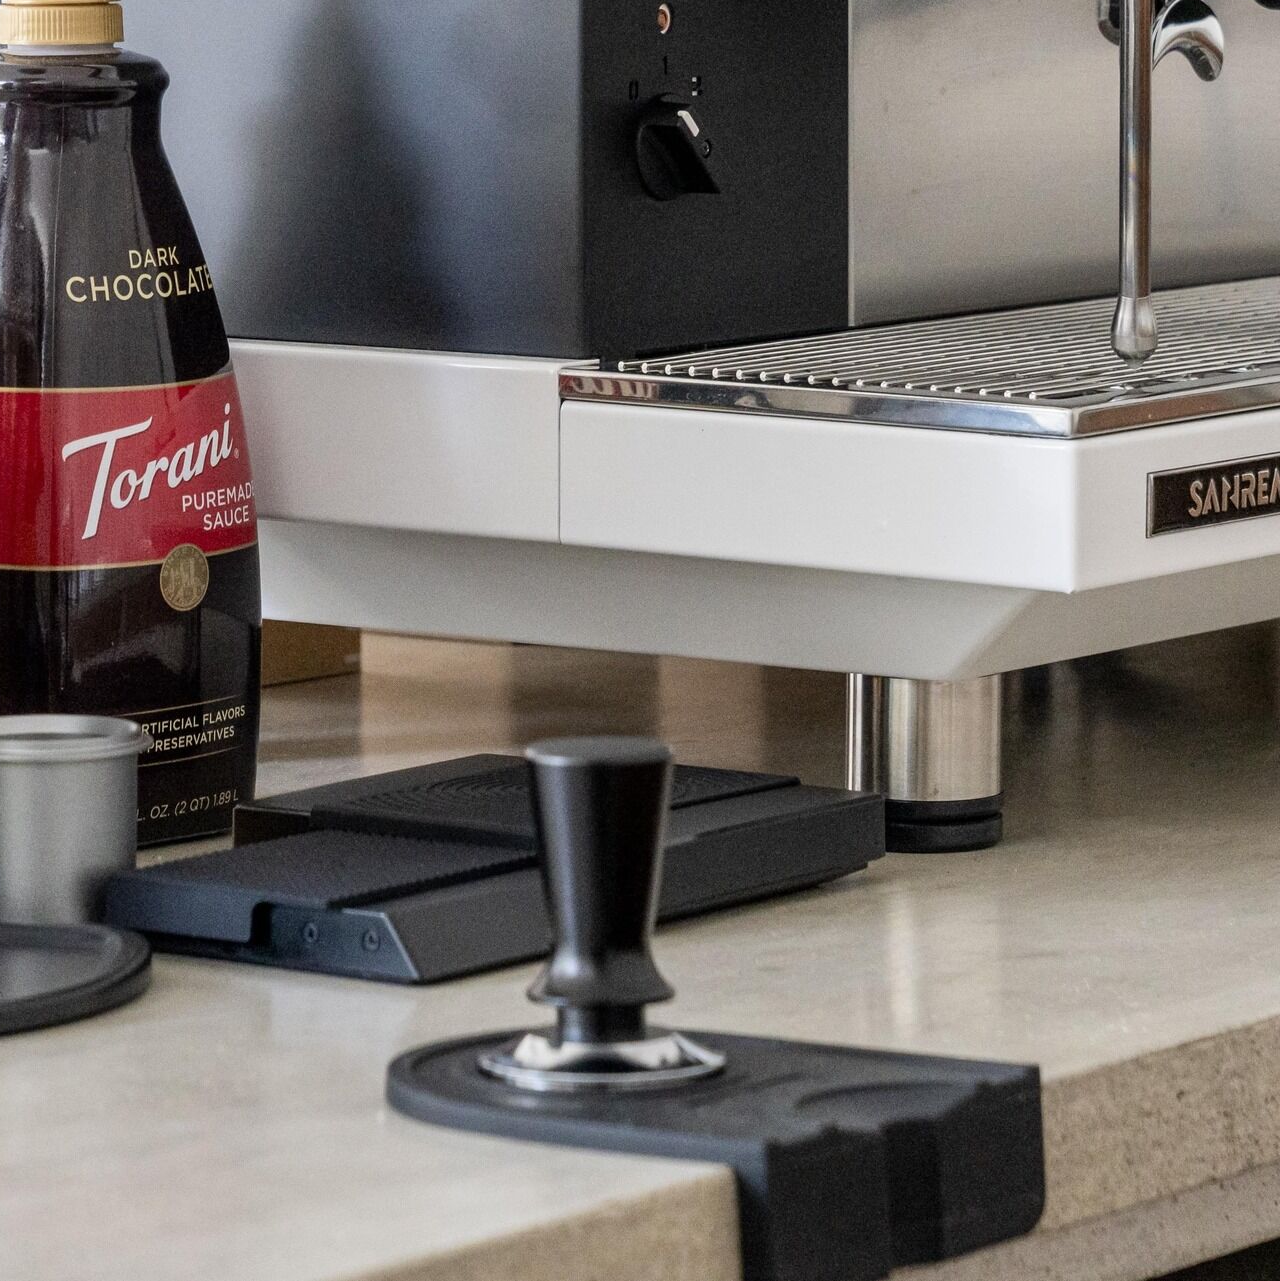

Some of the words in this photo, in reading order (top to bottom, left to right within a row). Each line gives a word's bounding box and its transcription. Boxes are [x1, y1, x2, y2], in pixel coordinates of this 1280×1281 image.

[128, 245, 180, 269] DARK
[65, 263, 214, 303] CHOCOLATE
[61, 402, 234, 540] Torani
[202, 504, 250, 531] SAUCE
[141, 714, 200, 736] RTIFICIAL
[202, 704, 246, 726] FLAVORS
[136, 807, 146, 822] L.
[150, 803, 170, 820] OZ.
[174, 799, 186, 817] (2
[189, 794, 210, 813] QT)
[213, 789, 232, 807] 1.89
[233, 788, 239, 802] L
